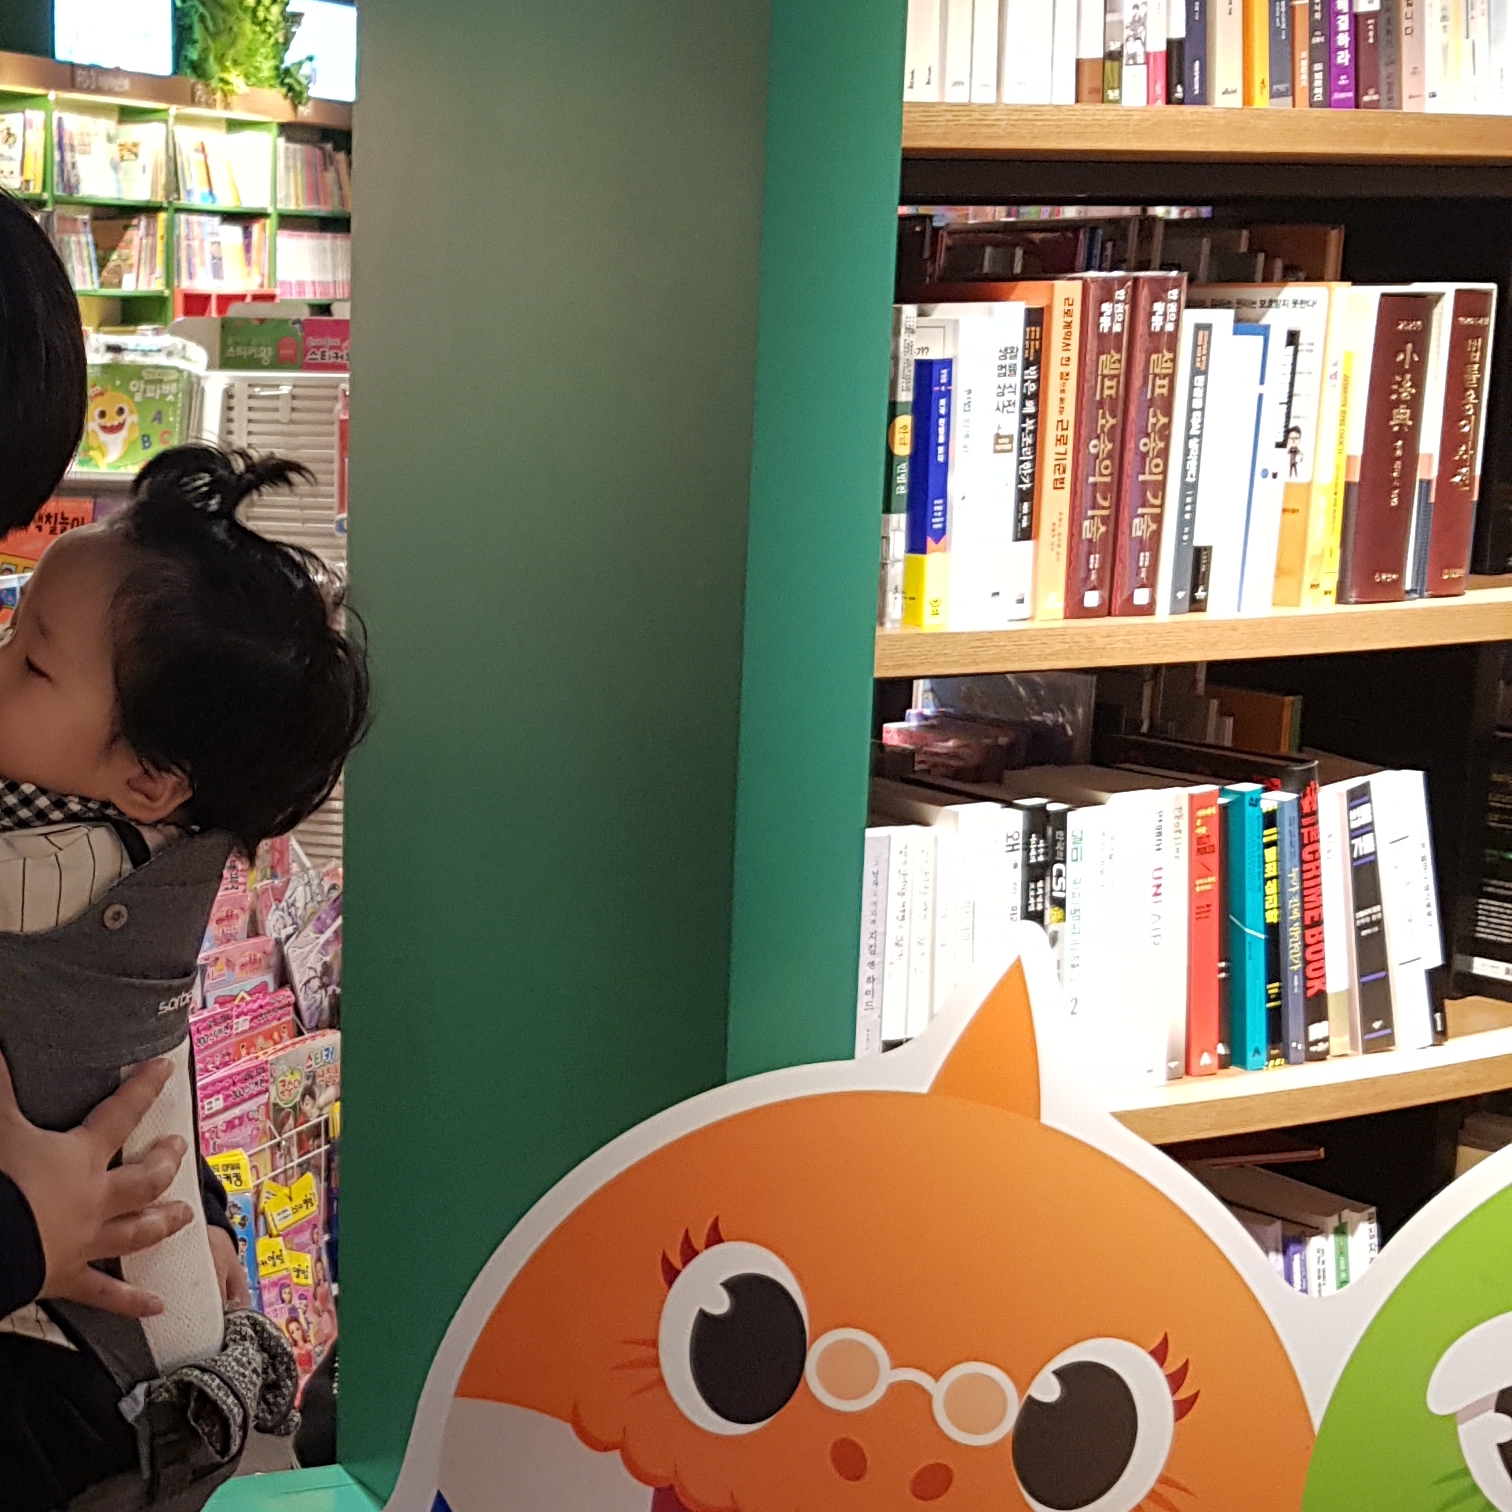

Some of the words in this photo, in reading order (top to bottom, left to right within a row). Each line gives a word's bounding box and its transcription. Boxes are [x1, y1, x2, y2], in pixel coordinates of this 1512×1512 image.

[1021, 364, 1039, 396] 법은
[1096, 349, 1122, 401] 셀프
[1147, 349, 1174, 401] 셀프
[141, 433, 152, 450] B
[160, 430, 172, 445] C
[1017, 417, 1037, 491] 부조리한가
[1052, 418, 1070, 491] 근로기준법
[1089, 408, 1117, 484] 소송의
[1139, 408, 1170, 483] 소송의
[1082, 492, 1112, 542] 기술
[1132, 490, 1163, 540] 기술
[1051, 863, 1066, 898] CSI
[1302, 843, 1323, 925] CRIME
[1304, 924, 1327, 999] BOOK
